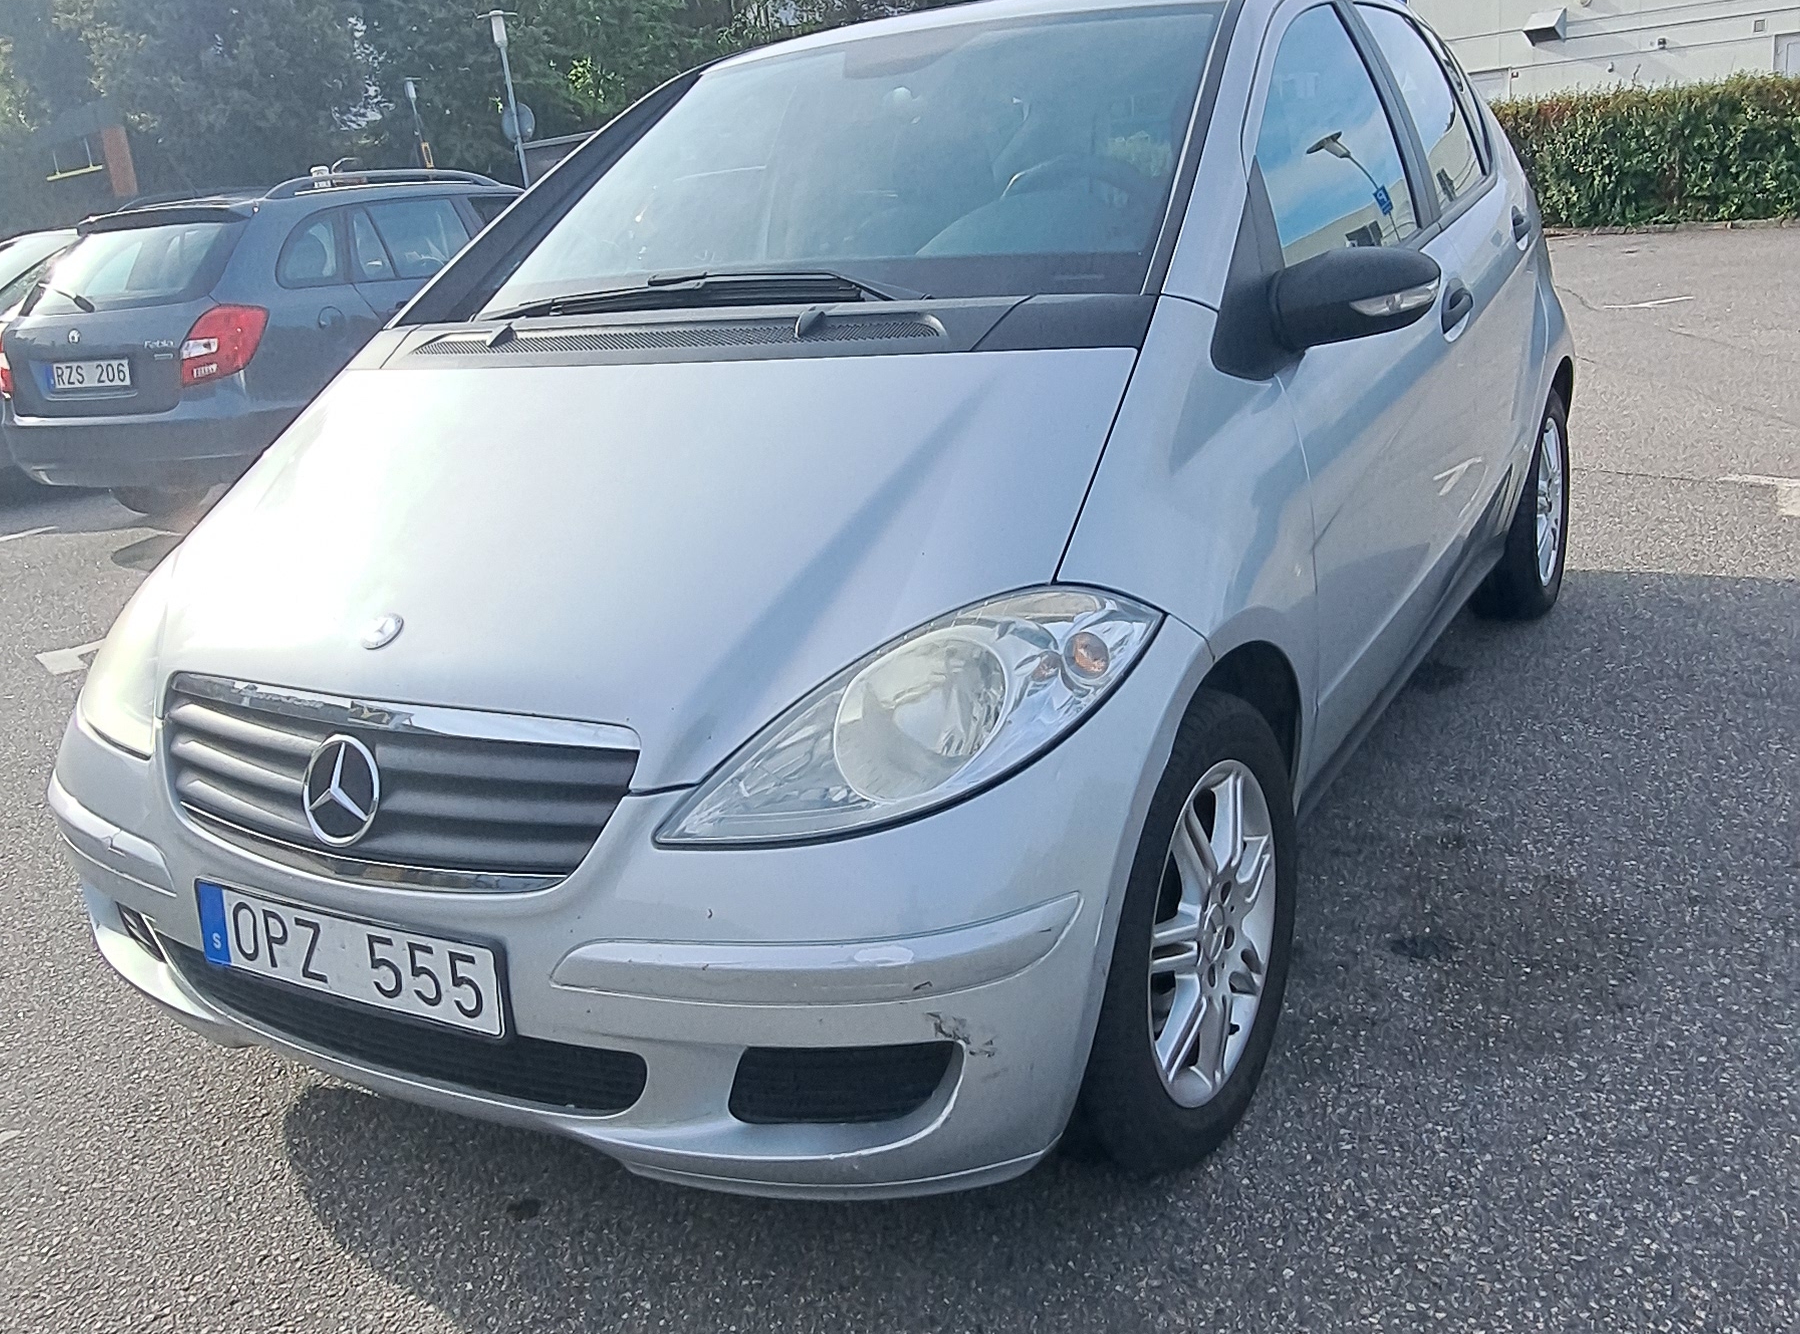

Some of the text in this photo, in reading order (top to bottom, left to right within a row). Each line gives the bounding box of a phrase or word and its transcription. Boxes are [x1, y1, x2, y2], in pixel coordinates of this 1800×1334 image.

[55, 362, 127, 386] RZS 206
[211, 931, 222, 950] S
[231, 901, 483, 1020] OPZ 555
